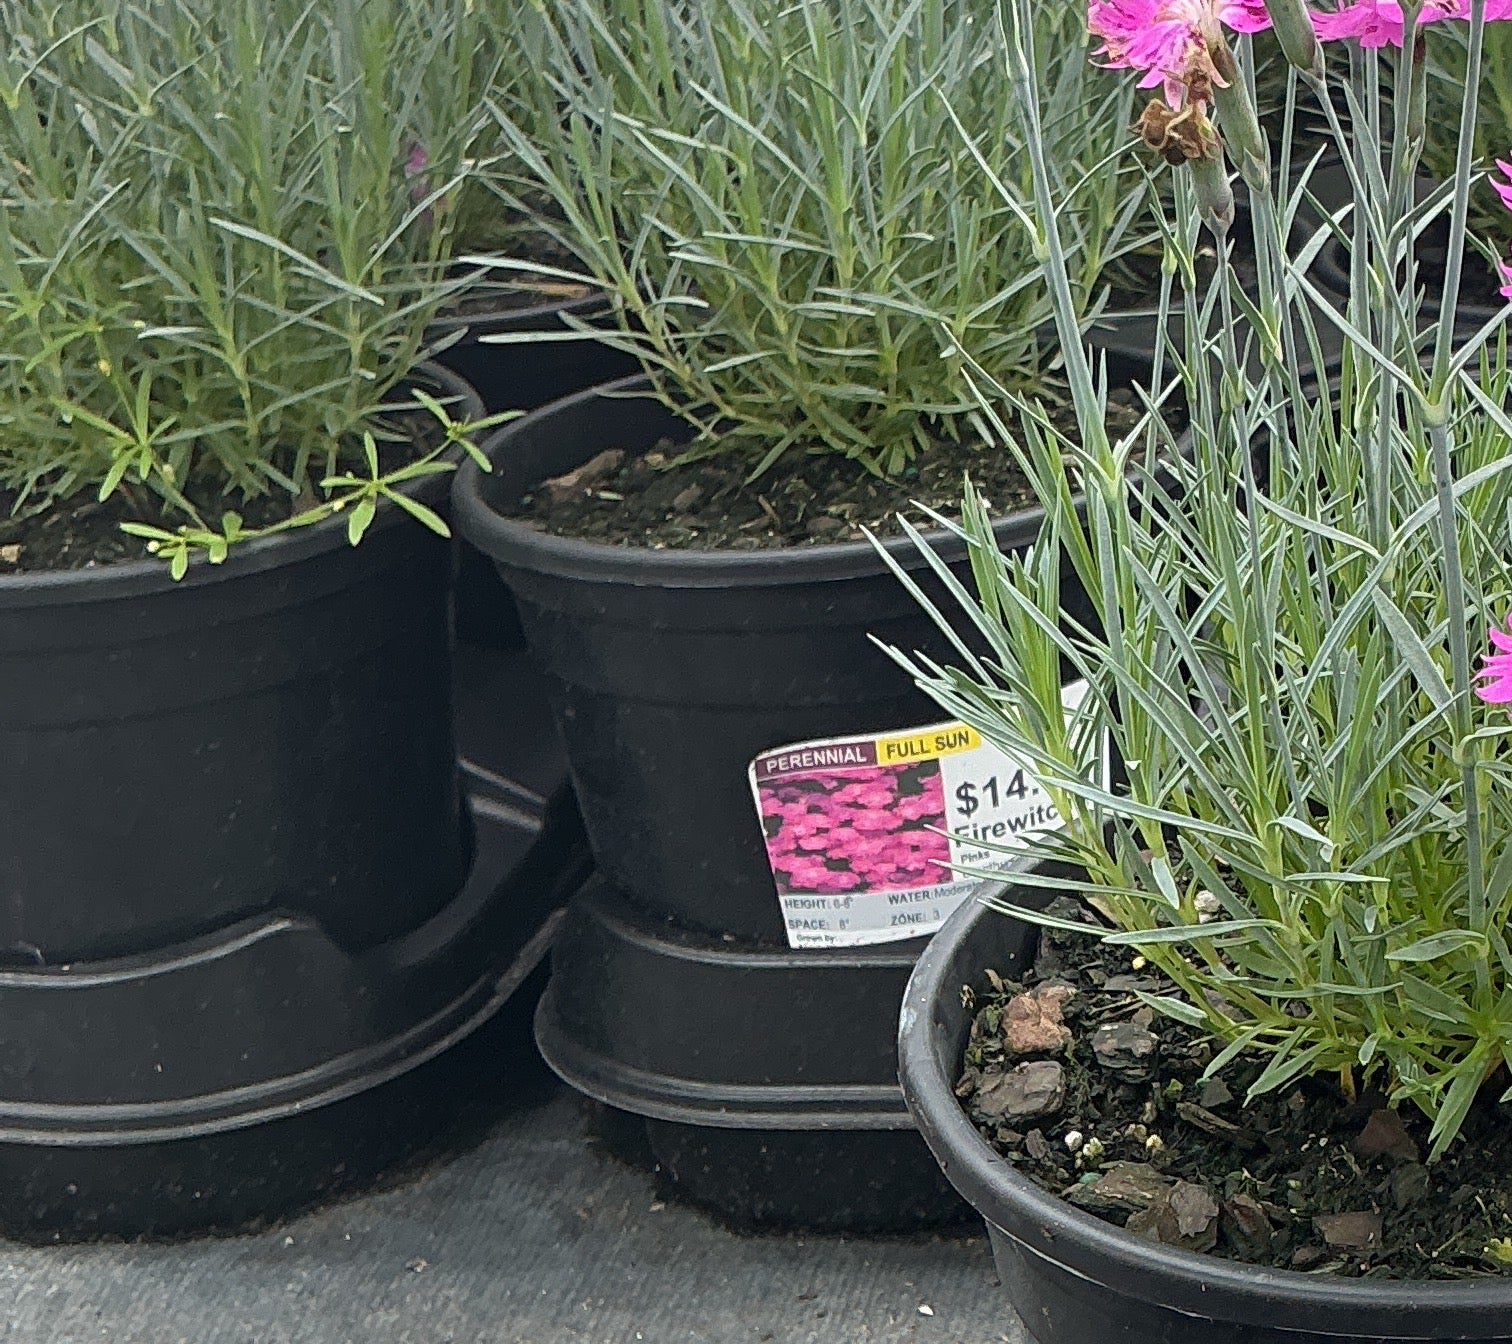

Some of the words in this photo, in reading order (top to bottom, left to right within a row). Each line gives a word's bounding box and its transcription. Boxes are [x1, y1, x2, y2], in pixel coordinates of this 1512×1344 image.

[886, 739, 932, 759] FULL
[935, 730, 970, 751] SUN
[766, 747, 867, 773] PERENNIAL
[955, 768, 1040, 818] $14.
[954, 803, 1059, 848] Firewitc
[784, 898, 831, 909] HEIGHT:
[788, 918, 831, 930] SPACE:
[891, 914, 927, 927] ZONE:
